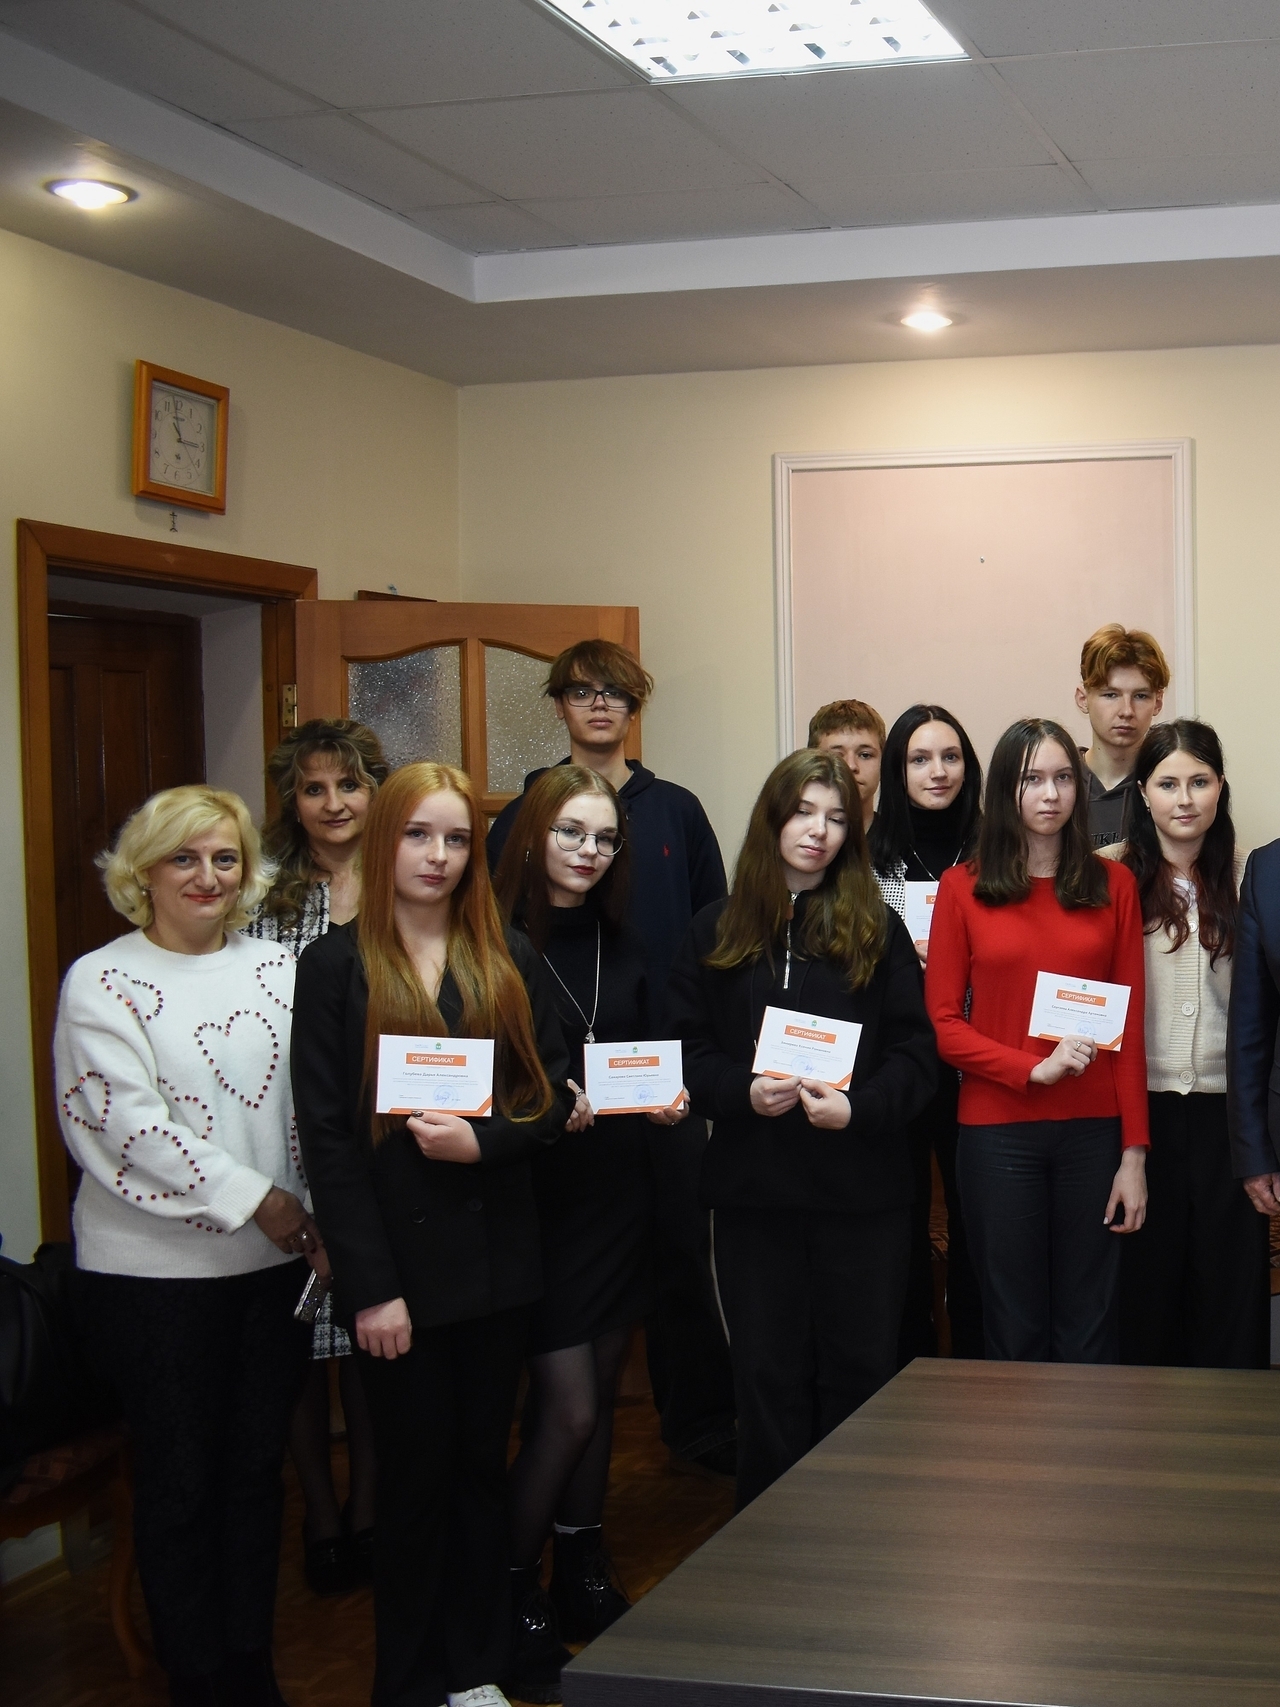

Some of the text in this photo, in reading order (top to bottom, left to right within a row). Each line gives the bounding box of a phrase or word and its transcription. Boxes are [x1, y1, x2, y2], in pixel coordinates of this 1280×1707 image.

[1061, 992, 1097, 1003] СЕРТИФИКАТ
[789, 1028, 826, 1040] СЕРТИФИКАТ
[411, 1055, 455, 1064] СЕРТИФИКАТ
